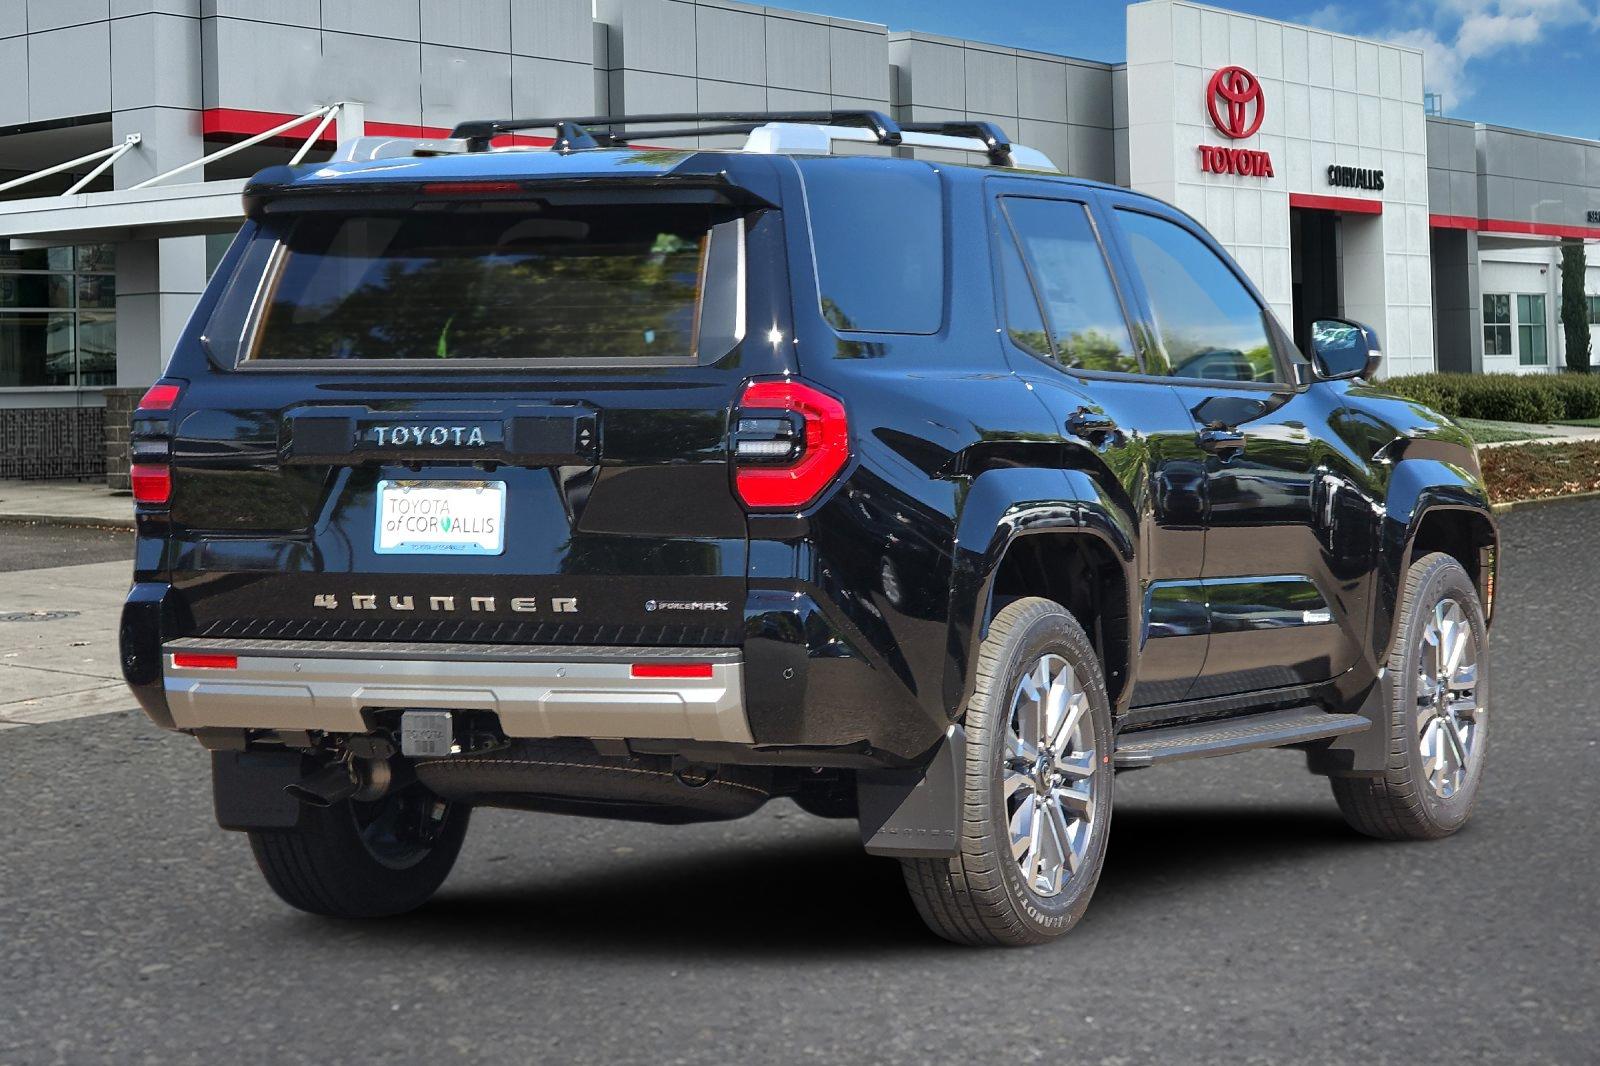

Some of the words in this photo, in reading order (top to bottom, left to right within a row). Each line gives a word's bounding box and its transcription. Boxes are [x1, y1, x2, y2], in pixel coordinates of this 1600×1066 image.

[1199, 144, 1275, 178] TOYOTA
[1327, 164, 1385, 191] CORVALLIS
[374, 426, 485, 446] TOYOTA
[389, 498, 450, 515] TOYOTA
[386, 515, 404, 532] of
[406, 516, 495, 533] CORVALLIS
[313, 593, 580, 613] 4RUNNER
